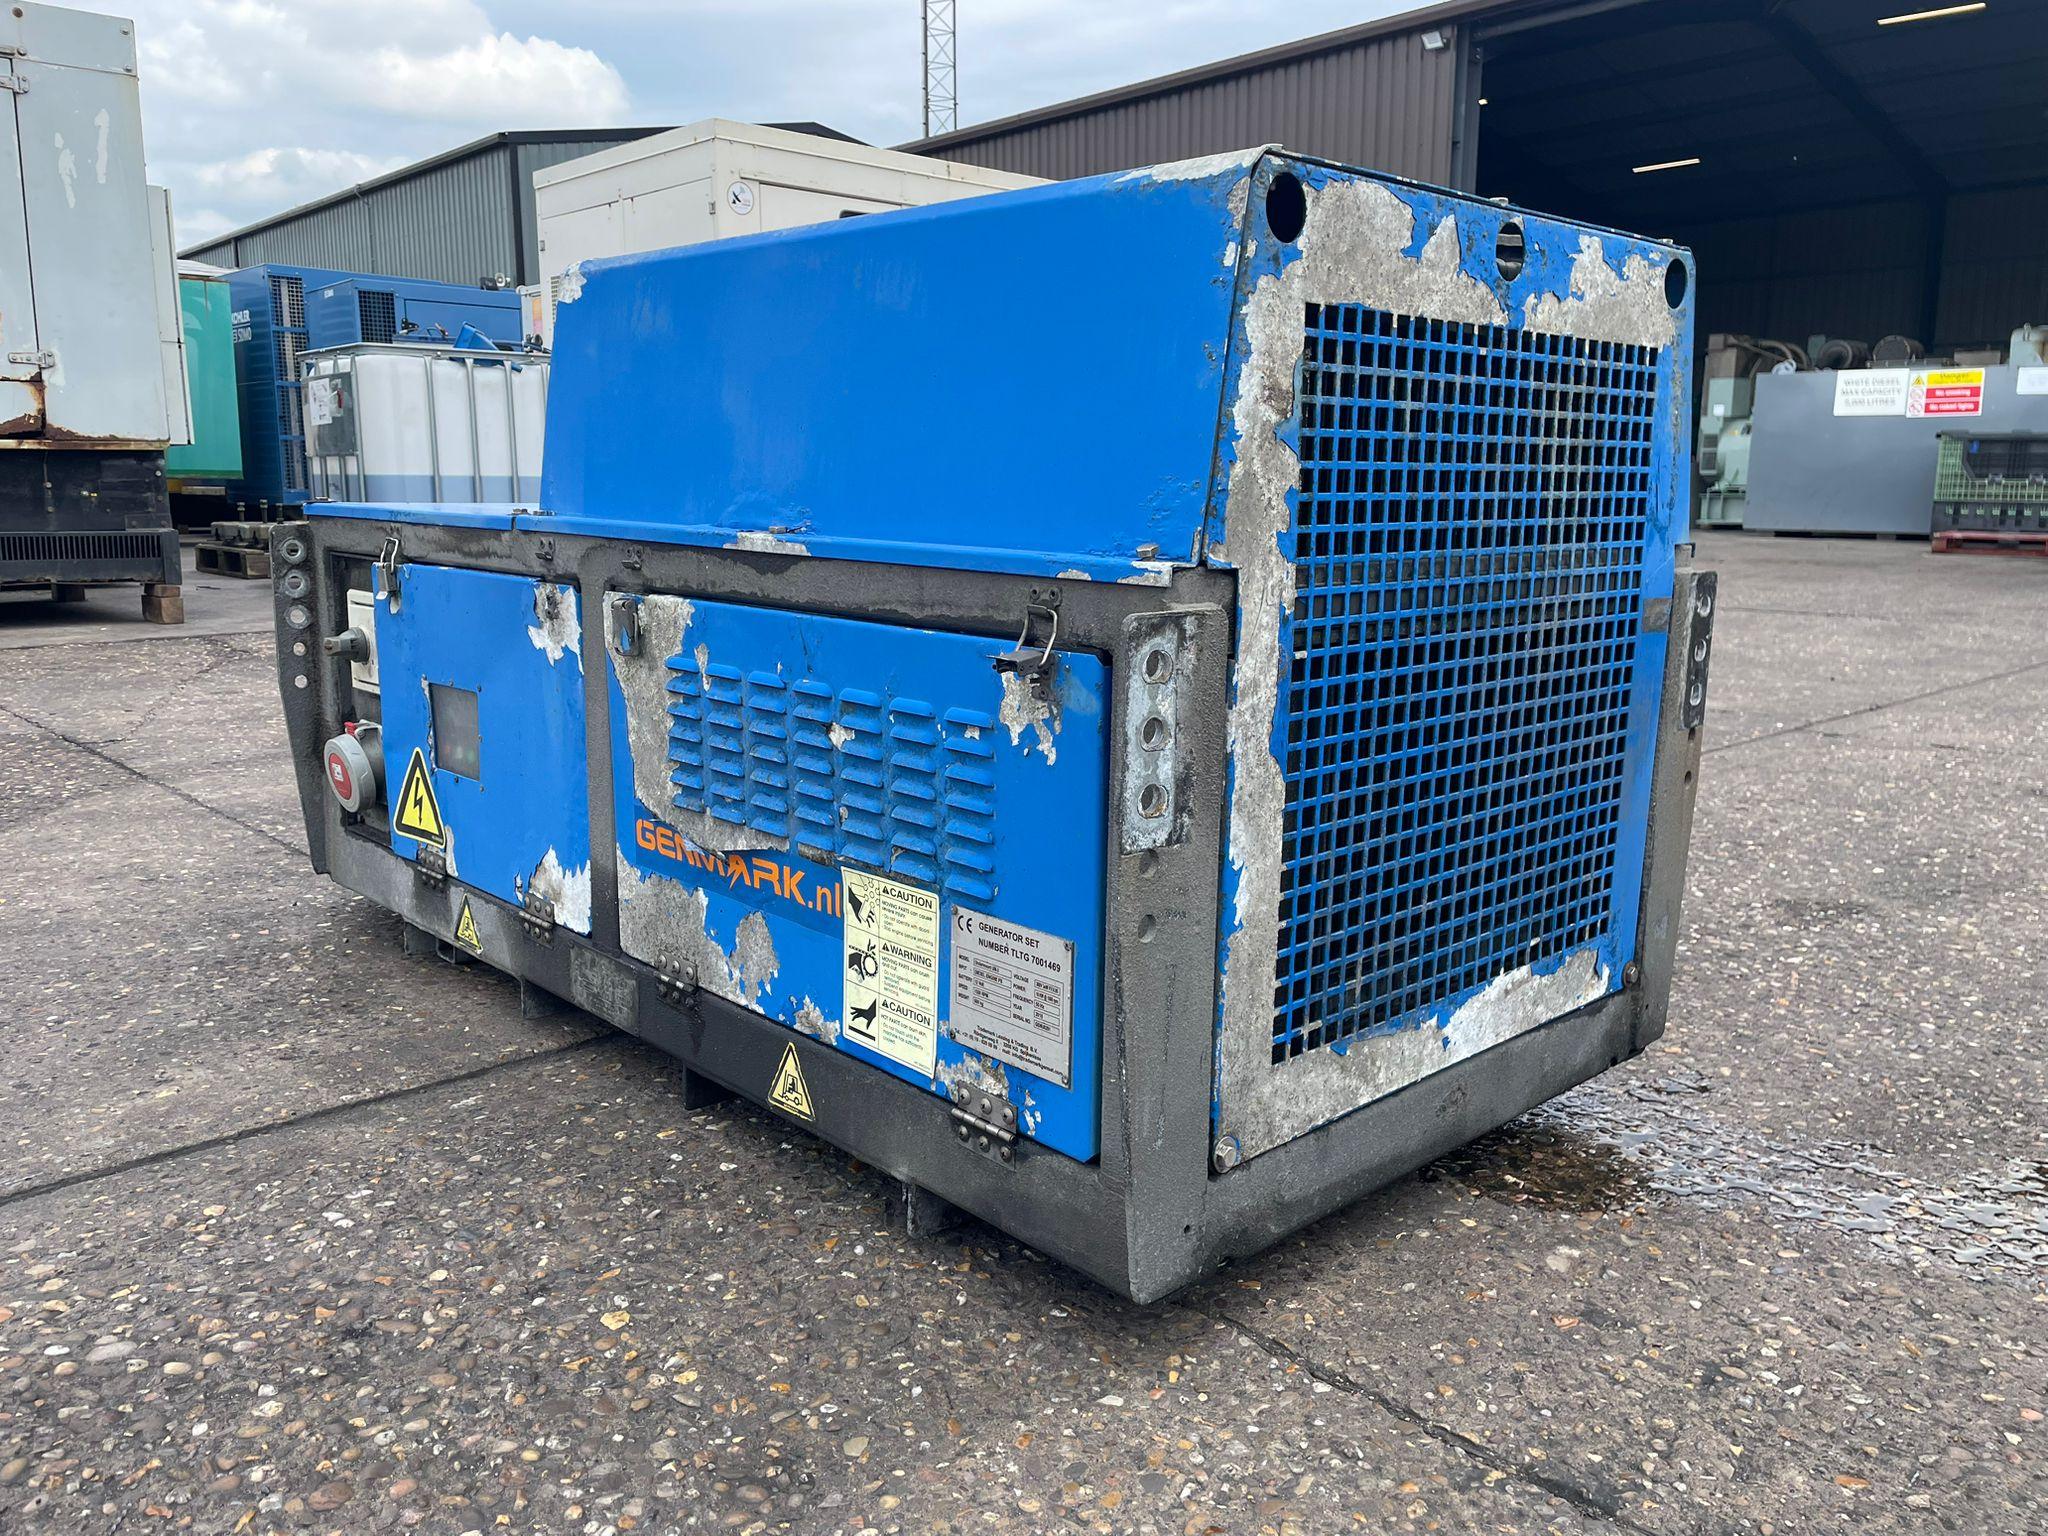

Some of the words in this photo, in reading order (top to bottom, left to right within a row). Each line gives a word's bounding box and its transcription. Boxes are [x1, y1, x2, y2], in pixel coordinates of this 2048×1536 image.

[1844, 377, 1870, 386] WHITE
[1872, 377, 1900, 385] DIESEL
[1841, 387, 1859, 396] MAX
[1861, 387, 1902, 395] CAPACITY
[1866, 397, 1896, 406] LITRES
[889, 887, 932, 909] CAUTION
[882, 900, 897, 910] MOVING
[898, 906, 909, 914] PARTS
[978, 921, 1024, 944] GENERATOR
[1025, 937, 1040, 949] SET
[889, 943, 932, 968] WARNING
[978, 937, 1009, 956] NUMBER
[1010, 948, 1030, 962] TLTG
[1031, 954, 1061, 973] 7001469
[882, 955, 898, 966] MOVING
[898, 962, 909, 971] PARTS
[910, 966, 918, 974] can
[1014, 973, 1029, 983] VOLTAGE
[1013, 983, 1026, 992] POWER
[1013, 993, 1034, 1005] FREQUENCY
[1013, 1003, 1022, 1011] YEAR
[889, 1001, 931, 1026] CAUTION
[1013, 1013, 1025, 1022] SERIAL
[889, 1017, 900, 1026] PARTS
